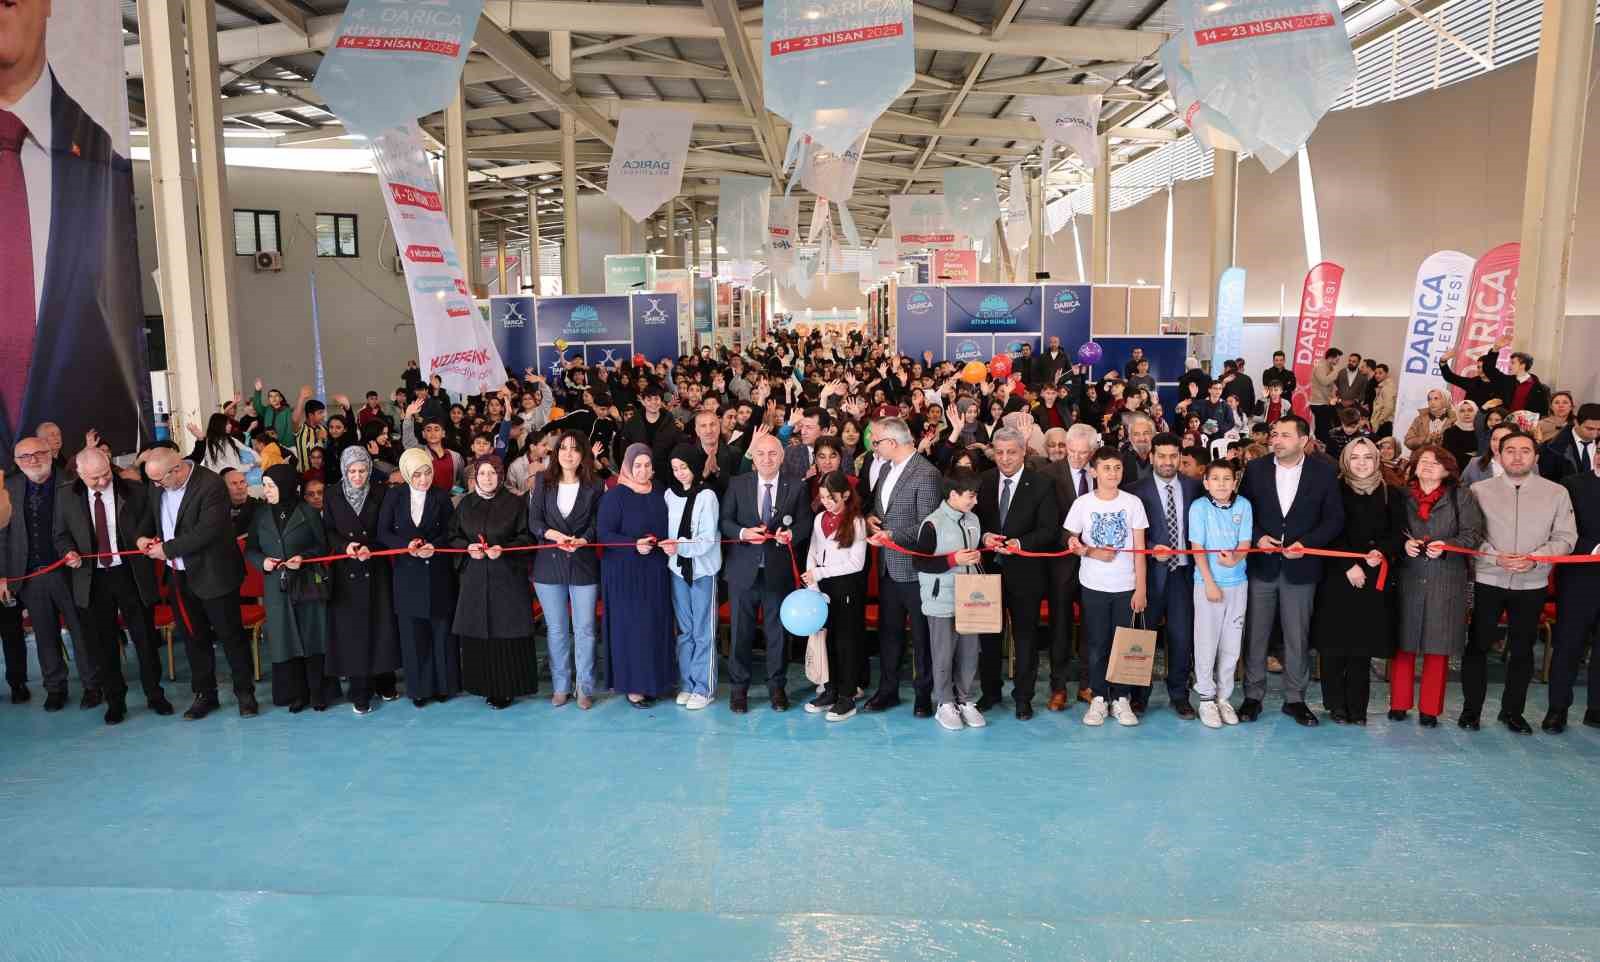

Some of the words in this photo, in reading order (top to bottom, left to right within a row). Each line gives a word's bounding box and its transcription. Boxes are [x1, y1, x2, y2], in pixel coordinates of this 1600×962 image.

[777, 41, 790, 52] 14
[803, 37, 818, 48] 23
[822, 30, 864, 45] NİSAN
[866, 25, 897, 39] 2025
[1202, 31, 1217, 41] 14
[1231, 26, 1247, 37] 23
[1250, 20, 1293, 34] NİSAN
[1295, 15, 1328, 27] 2025
[342, 37, 354, 46] 14
[367, 38, 380, 48] 23
[383, 37, 422, 49] NİSAN
[423, 43, 454, 54] 2025
[1296, 280, 1325, 365] DARICA
[1405, 274, 1446, 375] DARICA
